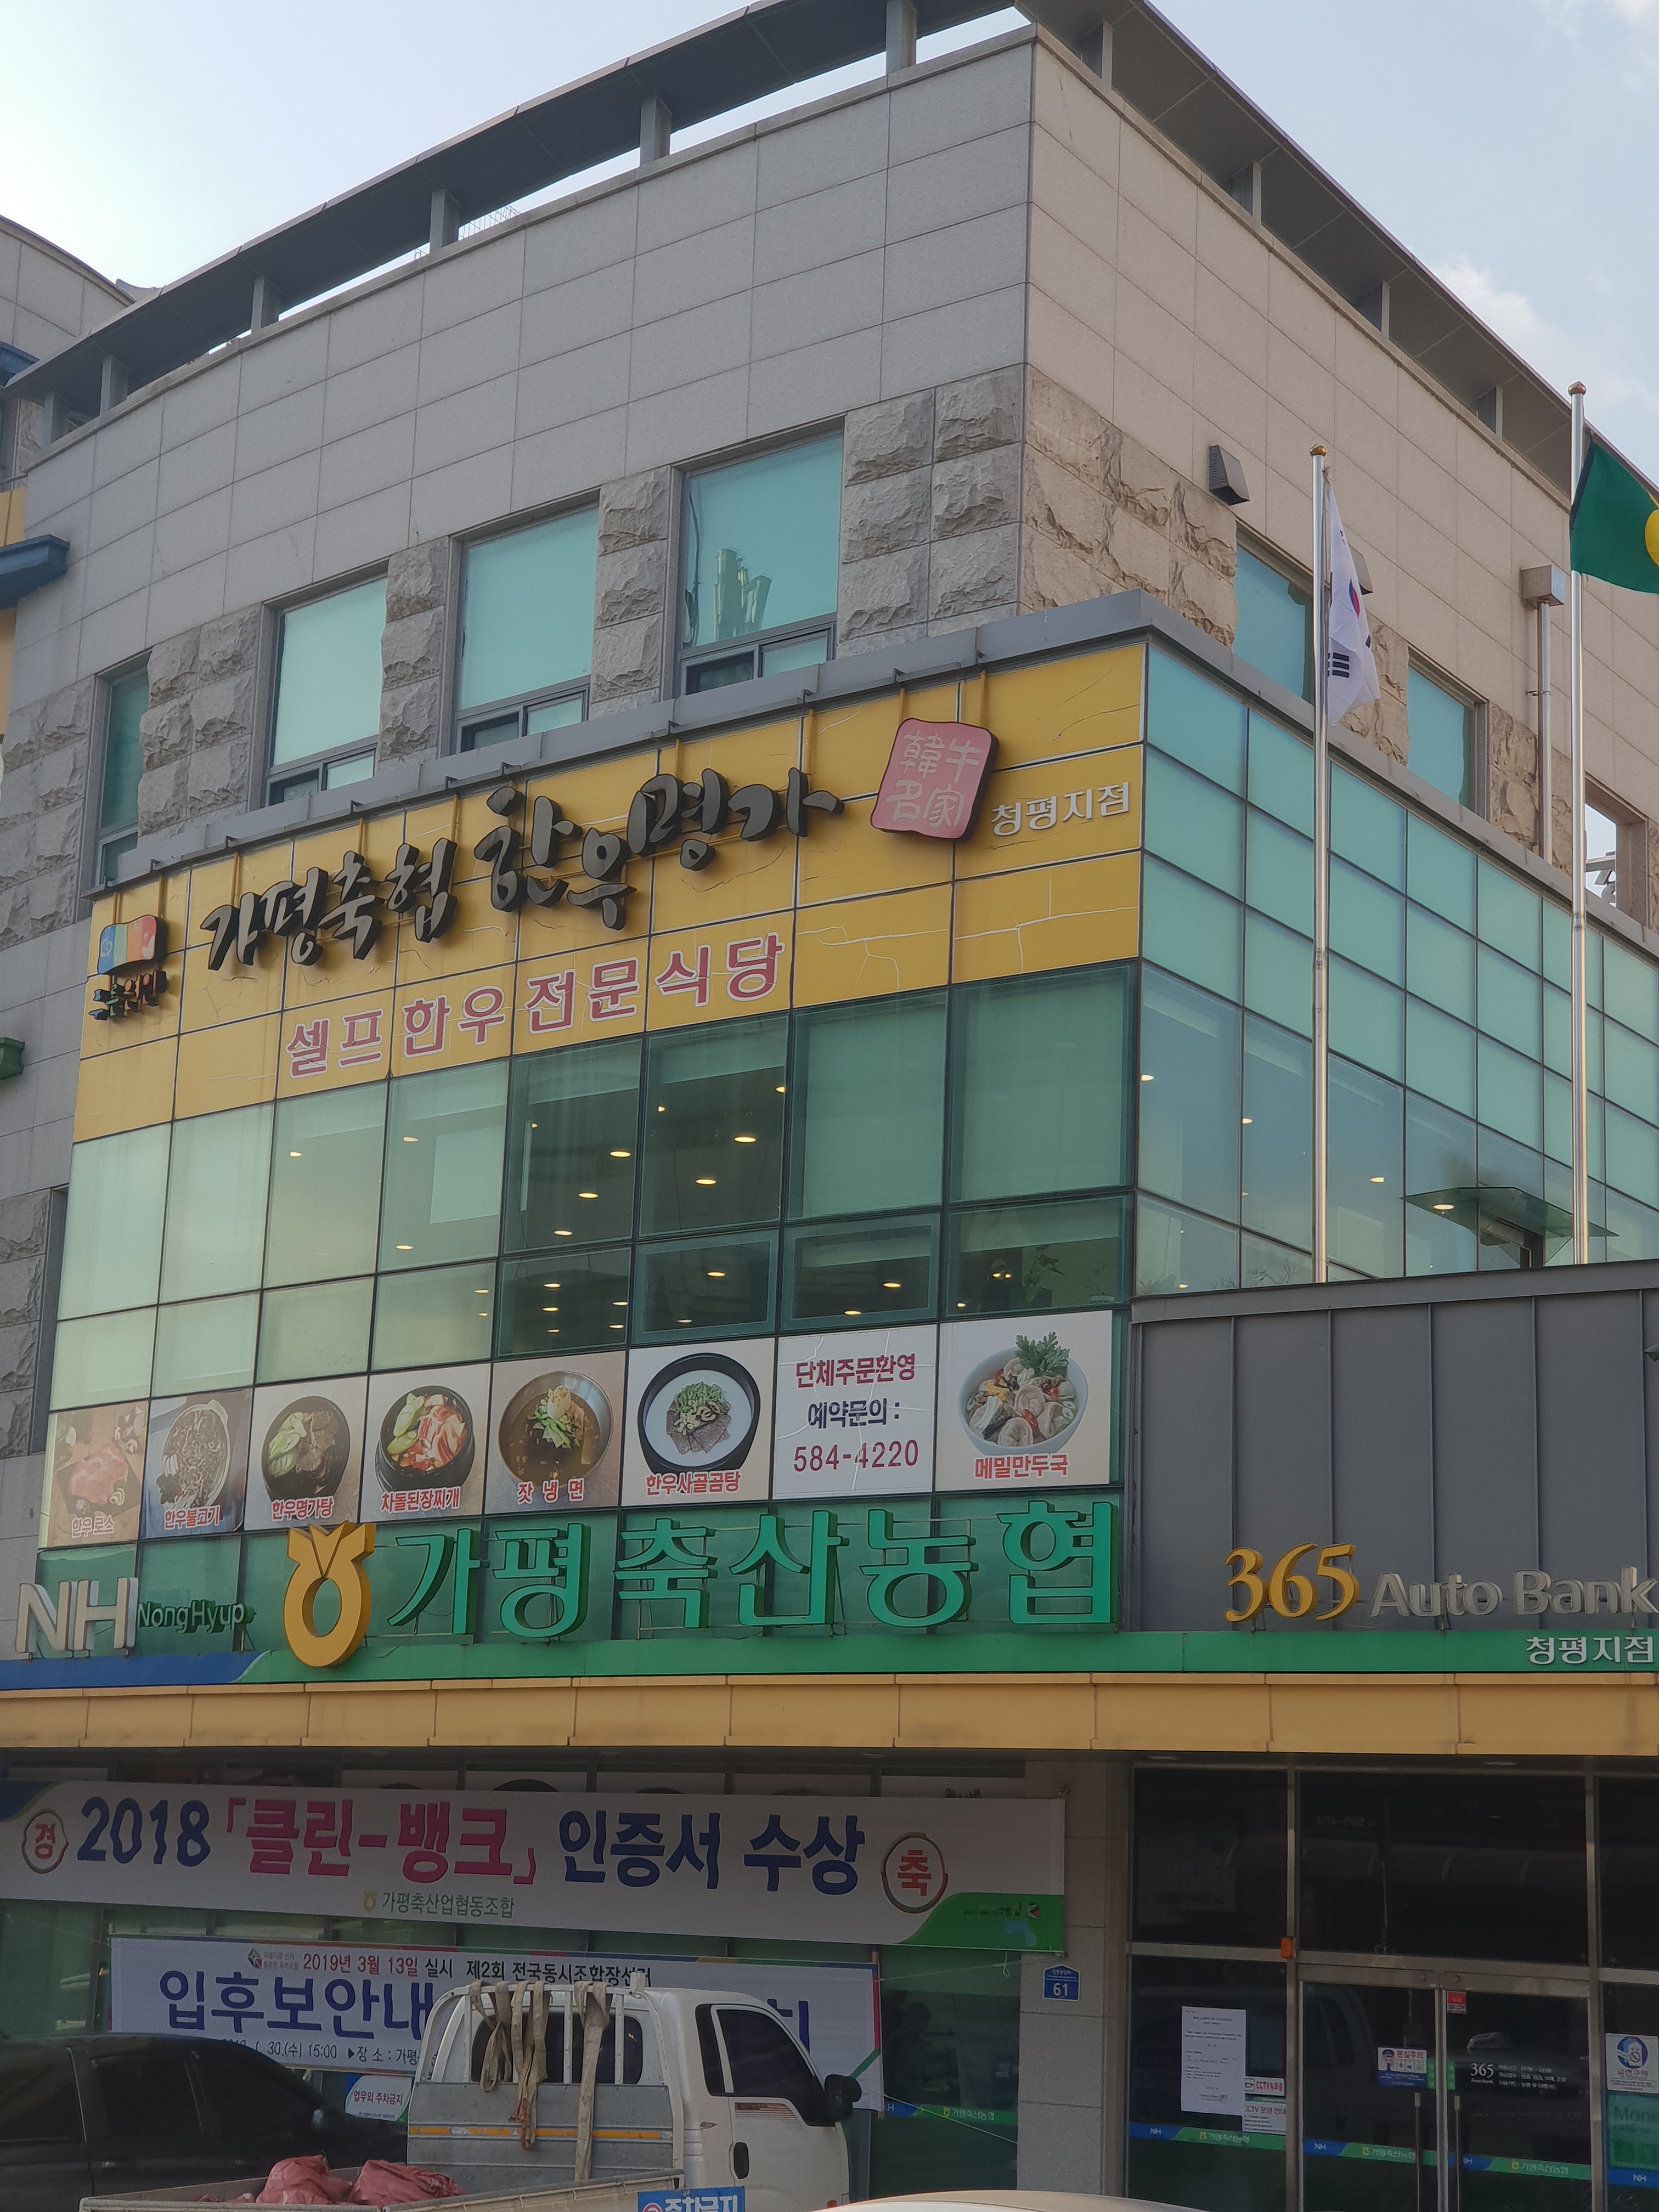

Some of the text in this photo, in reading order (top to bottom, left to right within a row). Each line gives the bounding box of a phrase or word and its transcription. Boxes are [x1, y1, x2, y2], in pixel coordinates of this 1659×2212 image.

[991, 782, 1130, 837] 청평지점
[200, 768, 844, 970] 가평축협 한우명가
[795, 1352, 916, 1389] 단체주문환영
[793, 1439, 919, 1472] 584-4220
[974, 1453, 1069, 1480] 메밀만두국
[646, 1471, 741, 1498] 한우사골곰탕
[272, 1496, 334, 1522] 한우명가탕
[381, 1486, 460, 1513] 차돌된장찌개
[164, 1505, 220, 1530] 한우불고기
[387, 1500, 1118, 1638] 가평축산농협
[1224, 1542, 1659, 1622] 365 Auto Bank
[16, 1577, 253, 1652] NH NongHyup
[1526, 1635, 1655, 1664] 청평지점
[34, 1823, 56, 1860] 경
[77, 1797, 211, 1867] 2018
[558, 1809, 721, 1890] 인증서
[744, 1813, 865, 1895] 수상
[897, 1849, 932, 1897] 축
[382, 1891, 515, 1918] 가평축산업협동조합
[303, 1953, 351, 1974] 2019년
[358, 1956, 380, 1975] 3월
[388, 1957, 418, 1977] 13일
[425, 1958, 453, 1978] 실시
[466, 1960, 505, 1981] 제2회
[1053, 1982, 1068, 1996] 61
[308, 2044, 337, 2059] 15:00
[1470, 2063, 1494, 2078] 365
[354, 2090, 403, 2106] 업무외 주차금지
[1633, 2174, 1646, 2182] NH
